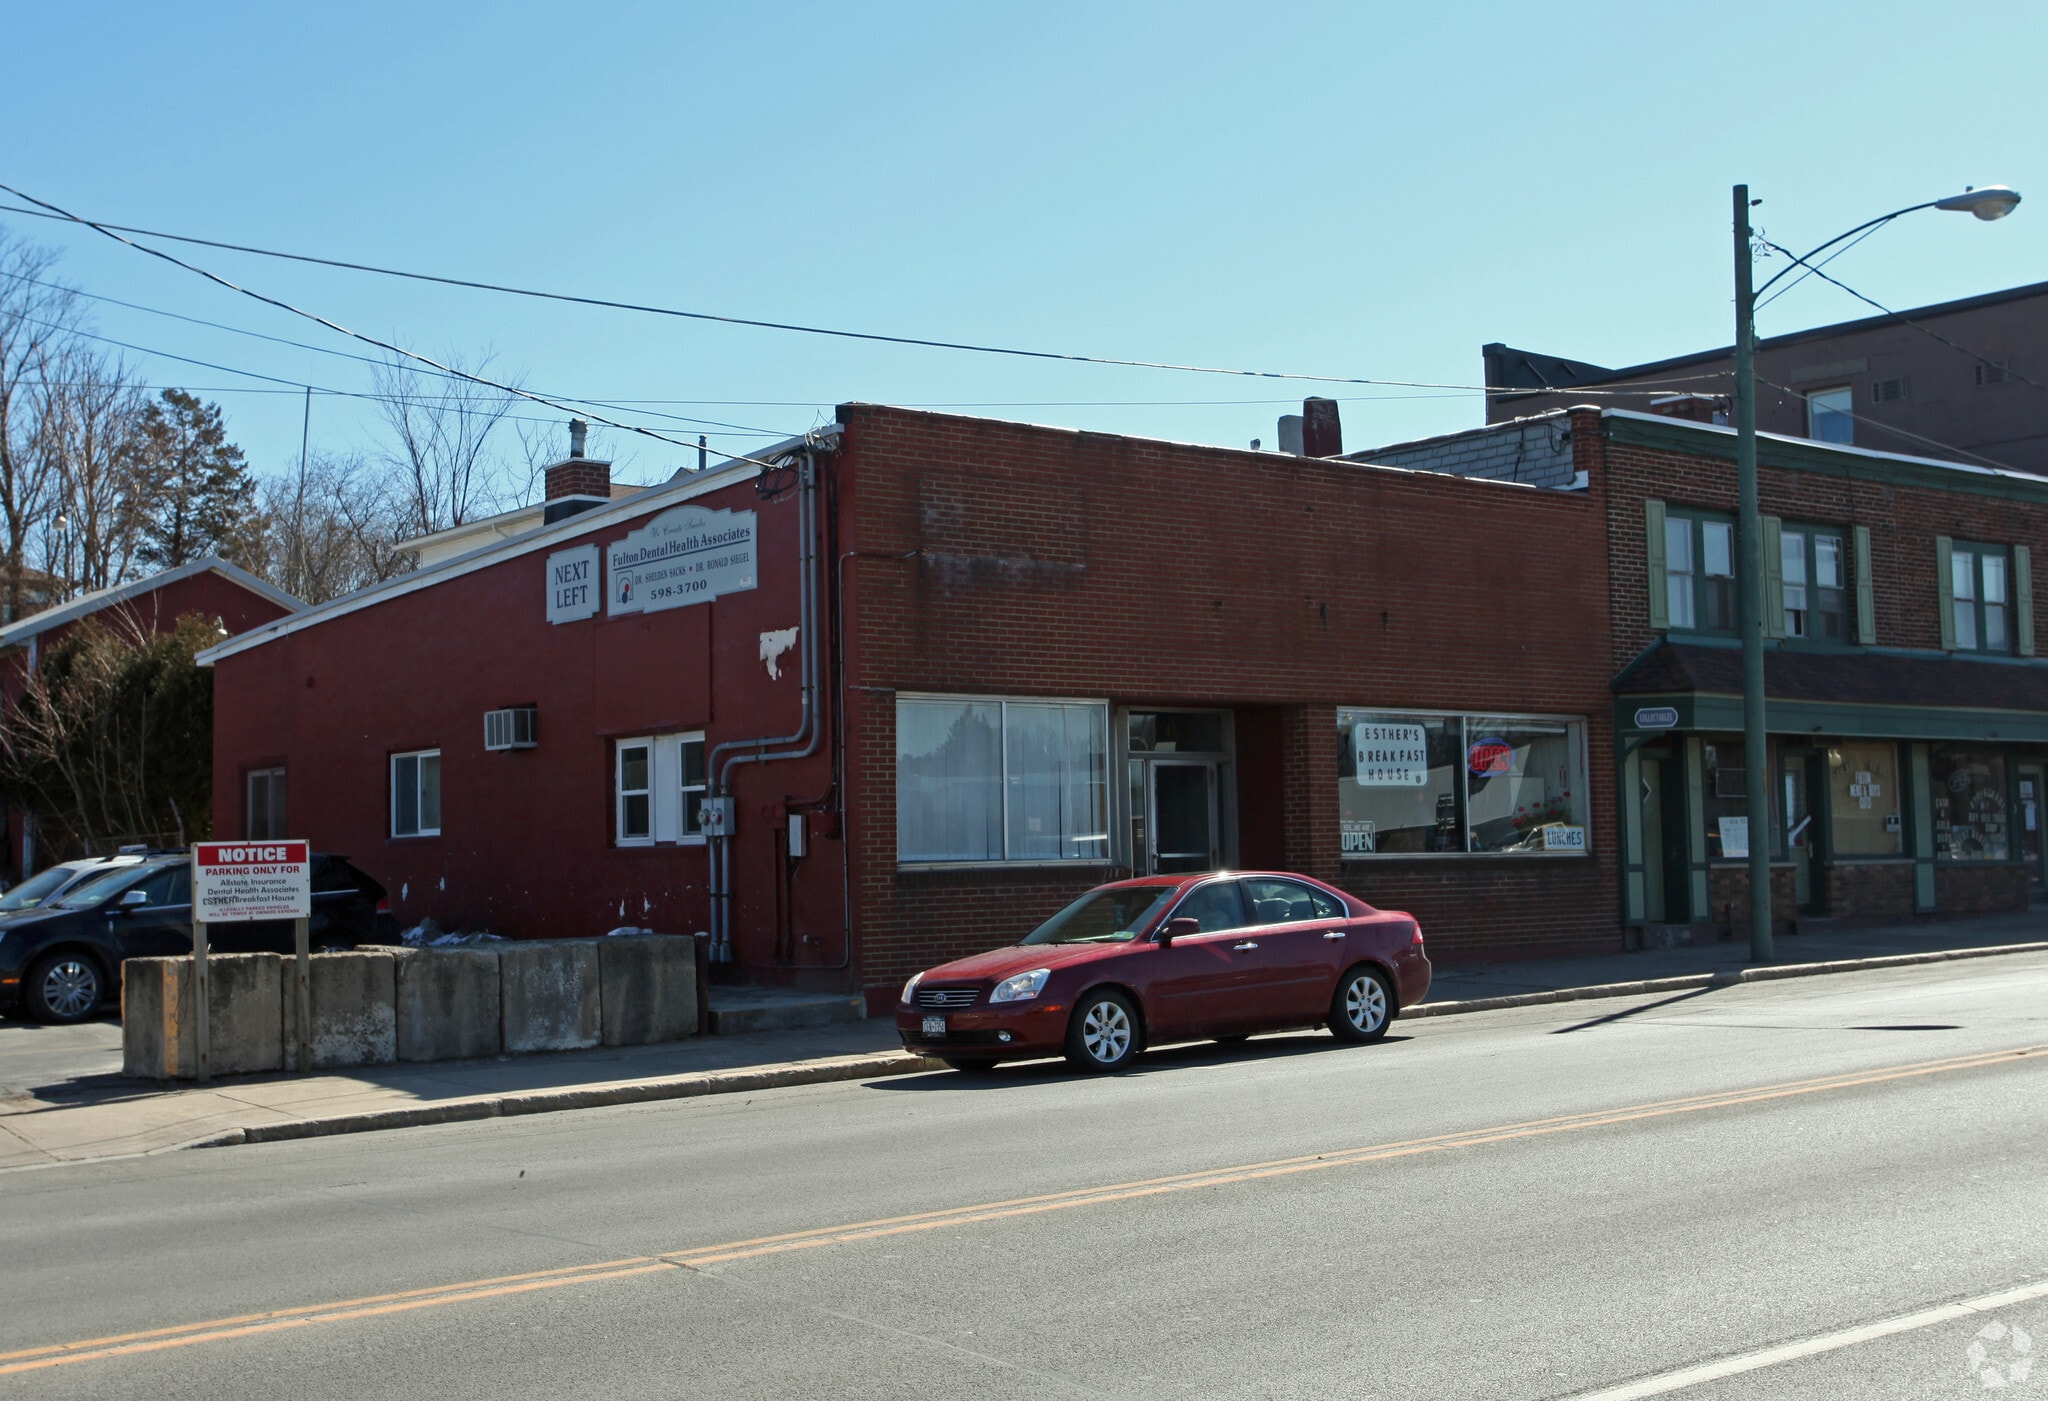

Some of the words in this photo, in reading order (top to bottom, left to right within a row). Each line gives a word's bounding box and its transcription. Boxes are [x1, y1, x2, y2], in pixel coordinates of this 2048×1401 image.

[613, 550, 639, 567] Fulton
[640, 542, 668, 560] Dental
[669, 536, 699, 555] Health
[701, 525, 750, 546] Associates
[555, 560, 590, 585] NEXT
[635, 575, 643, 585] DR.
[645, 569, 668, 583] SHELDEN
[669, 566, 686, 578] SACKS
[695, 562, 704, 573] DR.
[707, 556, 729, 570] RONALD
[730, 552, 750, 566] SIEGEL
[556, 585, 589, 609] LEFT
[650, 579, 708, 600] 598-3700
[1365, 727, 1419, 741] ESTHER'S
[1358, 750, 1425, 763] BREAKFAST
[1470, 746, 1511, 771] OPEN
[1368, 768, 1409, 781] HOUSE
[1341, 832, 1373, 851] OPEN
[1547, 831, 1582, 846] LUNCHES
[218, 847, 287, 862] NOTICE
[206, 867, 250, 876] PARKING
[253, 866, 278, 875] ONLY
[220, 879, 248, 887] Allstate
[234, 887, 259, 895] Health
[261, 886, 299, 894] Associates
